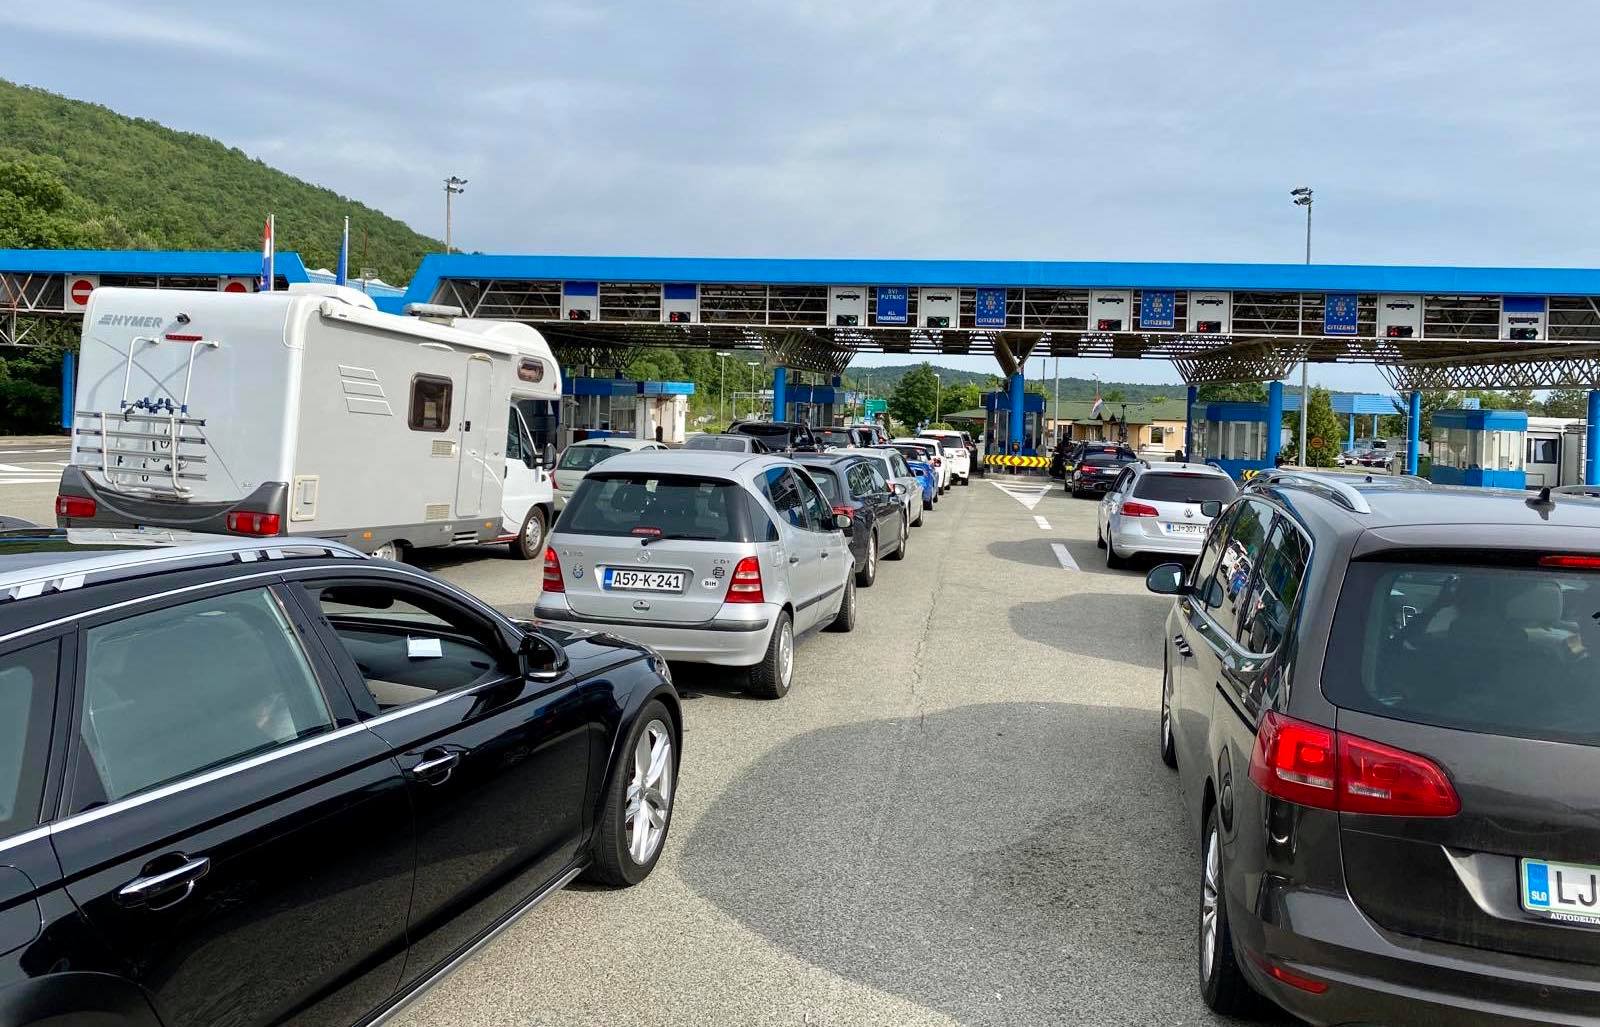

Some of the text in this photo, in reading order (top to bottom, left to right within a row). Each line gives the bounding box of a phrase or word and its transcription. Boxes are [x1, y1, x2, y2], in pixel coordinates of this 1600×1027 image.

[110, 314, 163, 329] HYMER
[614, 571, 680, 589] A59-K-241
[1530, 890, 1548, 902] SLO
[1556, 870, 1598, 907] LJ
